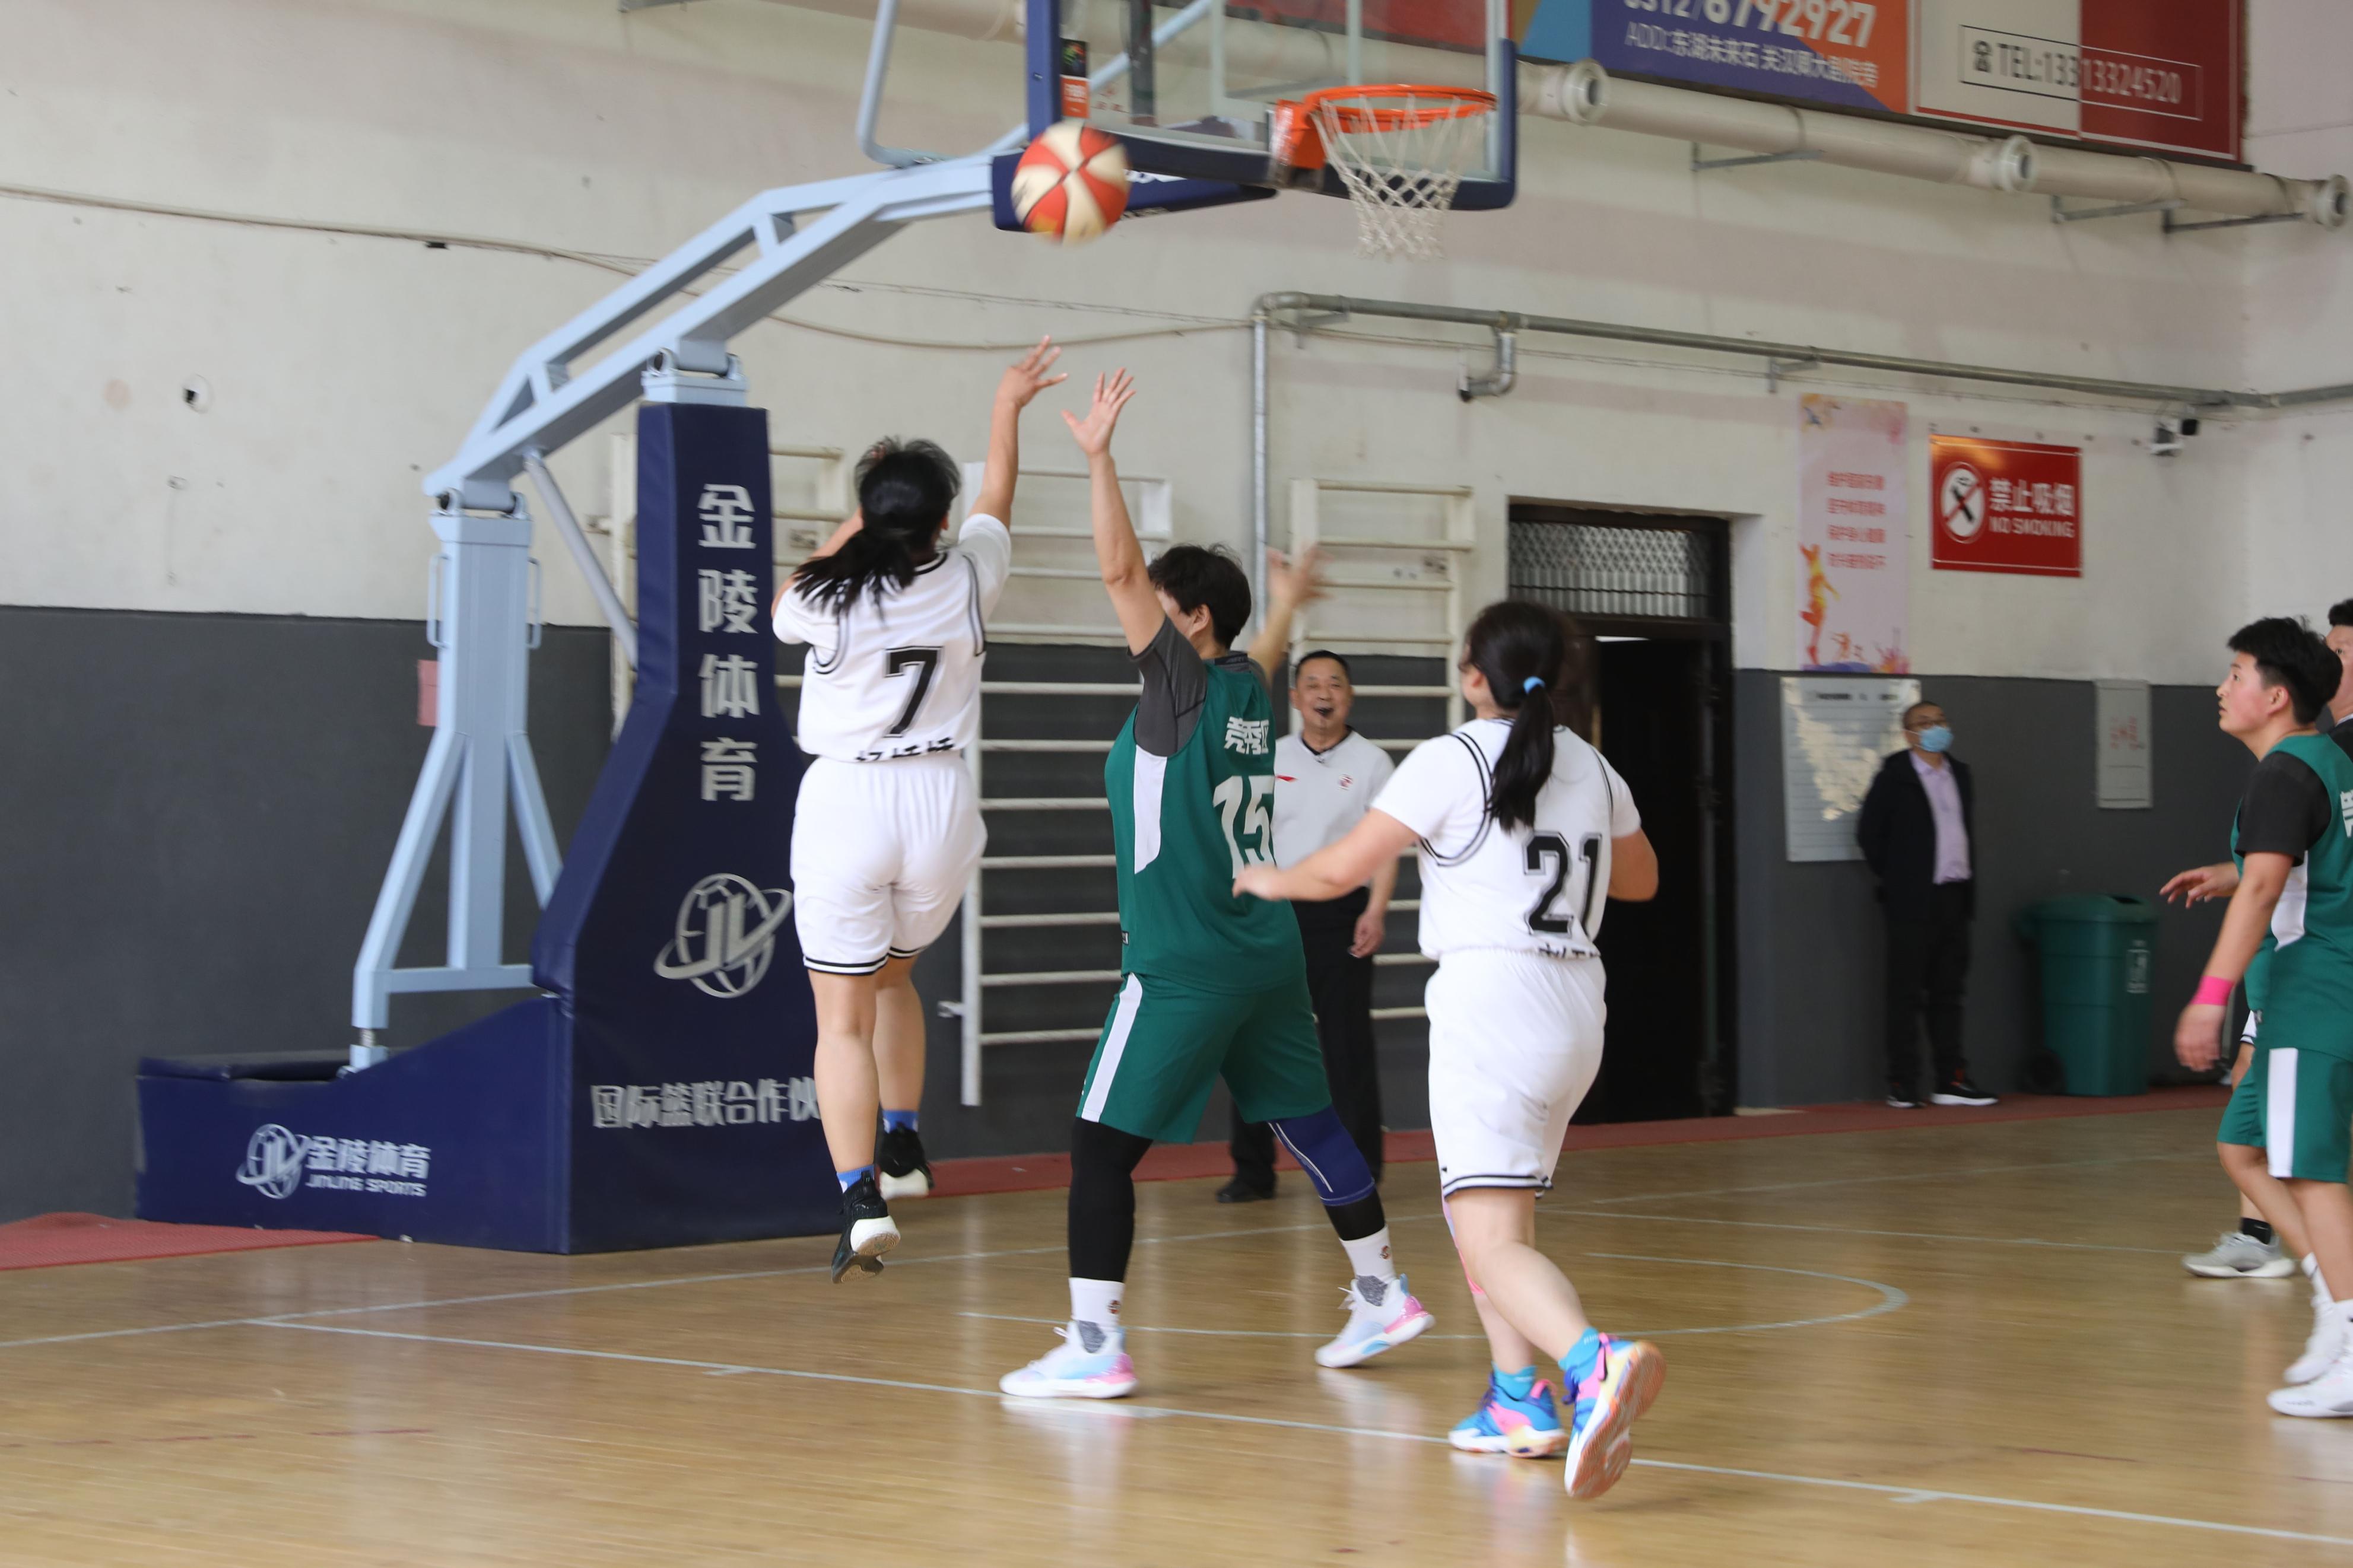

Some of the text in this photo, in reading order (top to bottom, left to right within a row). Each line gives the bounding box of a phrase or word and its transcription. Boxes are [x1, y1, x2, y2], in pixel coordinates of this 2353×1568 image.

[1989, 478, 2075, 517] 禁止吸烟
[1989, 516, 2075, 538] NO SMOKING
[698, 484, 760, 802] 金陵体育
[882, 645, 945, 738] 7
[1523, 830, 1602, 941] 21
[305, 1136, 431, 1179] 金陵体育
